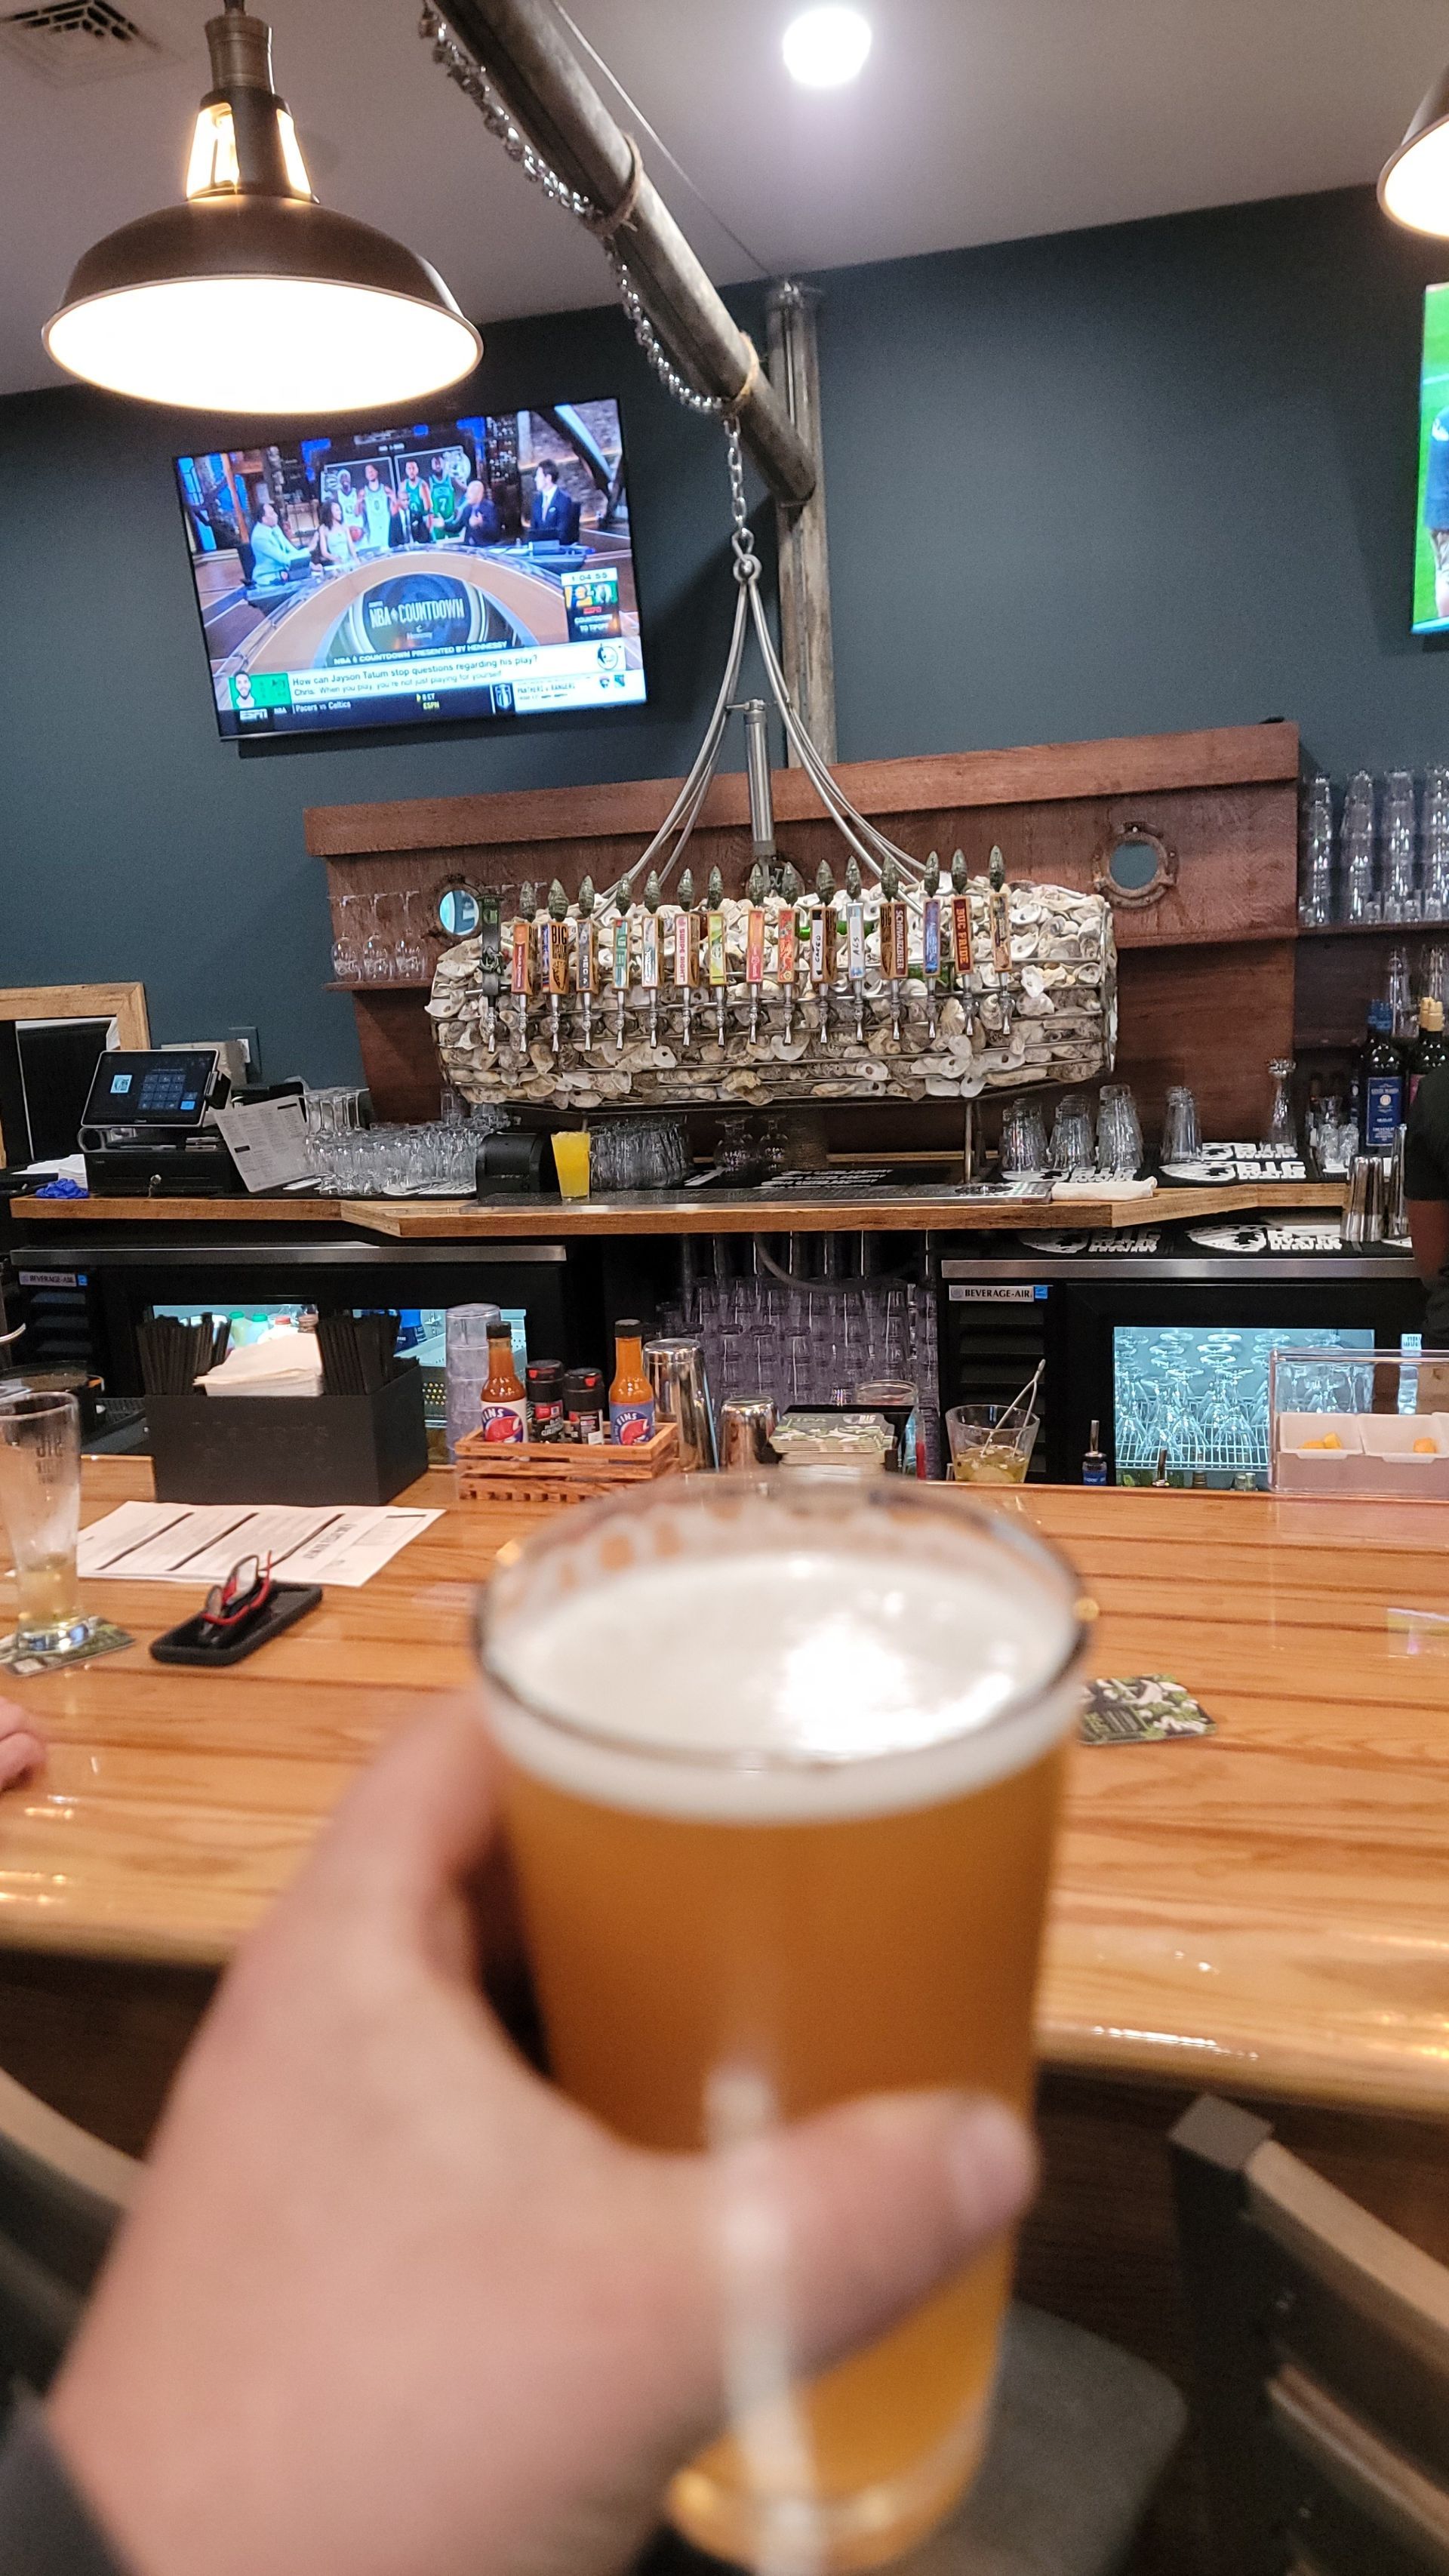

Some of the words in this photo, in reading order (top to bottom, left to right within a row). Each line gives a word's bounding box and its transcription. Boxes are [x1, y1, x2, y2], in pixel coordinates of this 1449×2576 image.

[369, 606, 392, 628] NBA
[398, 599, 465, 623] COUNTDOWN
[334, 656, 352, 665] NBA
[358, 650, 411, 663] COUNTDOWN
[411, 645, 455, 657] PRESENTED
[455, 645, 467, 654] BY
[293, 678, 311, 686] How
[331, 674, 361, 683] Jayson
[363, 670, 389, 679] Tatum
[391, 669, 410, 677] stop
[412, 665, 454, 676] questions
[456, 660, 497, 671] regarding
[515, 654, 537, 666] play?
[238, 708, 268, 721] ESPN
[296, 703, 318, 712] Pacers
[328, 700, 352, 710] Celtics
[551, 925, 568, 945] BIG
[895, 909, 905, 970] SCHWARZBIER
[958, 931, 969, 964] PRIDE
[964, 1288, 1030, 1297] BEVERAGE-AIR
[616, 1412, 637, 1426] FINS
